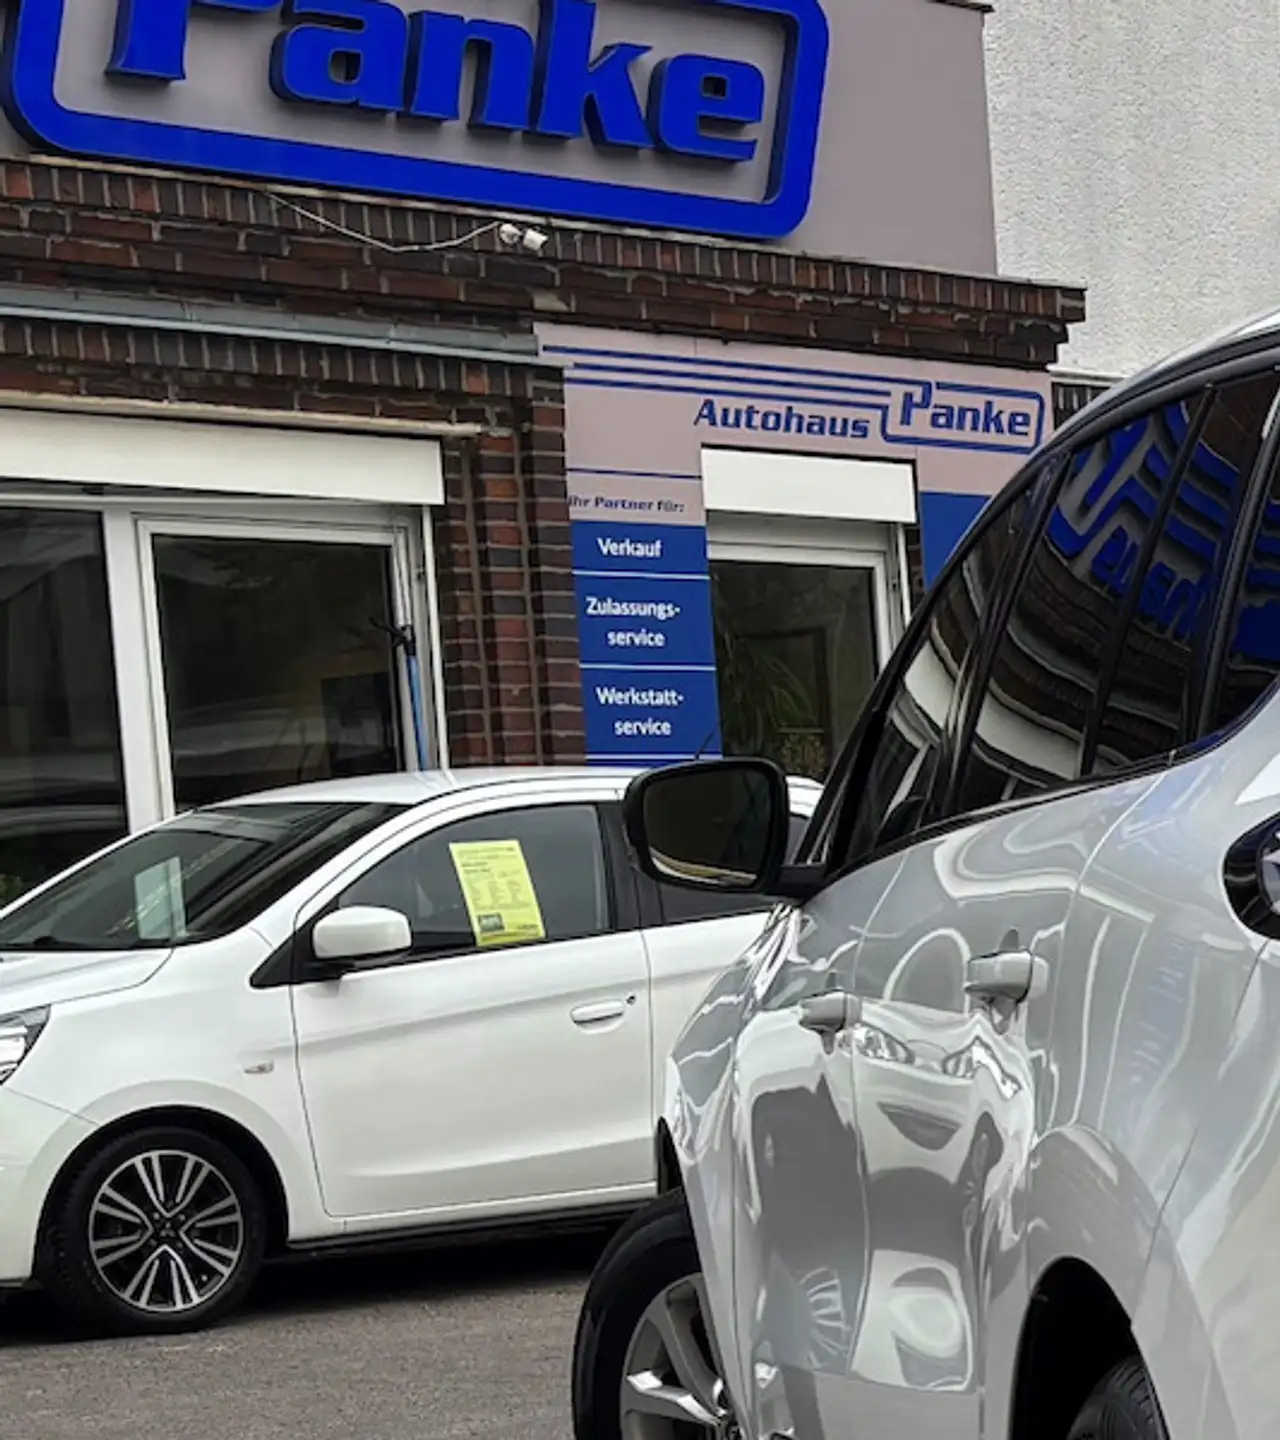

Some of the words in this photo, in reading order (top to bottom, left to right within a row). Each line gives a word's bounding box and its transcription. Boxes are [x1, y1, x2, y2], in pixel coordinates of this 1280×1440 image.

[693, 398, 870, 440] Autohaus
[900, 382, 1032, 437] Panke
[594, 496, 654, 511] Partner
[596, 536, 662, 558] Verkauf
[585, 596, 682, 621] Zulassungs-
[607, 627, 666, 647] service
[595, 686, 685, 706] Werkstatt-
[614, 717, 672, 736] service
